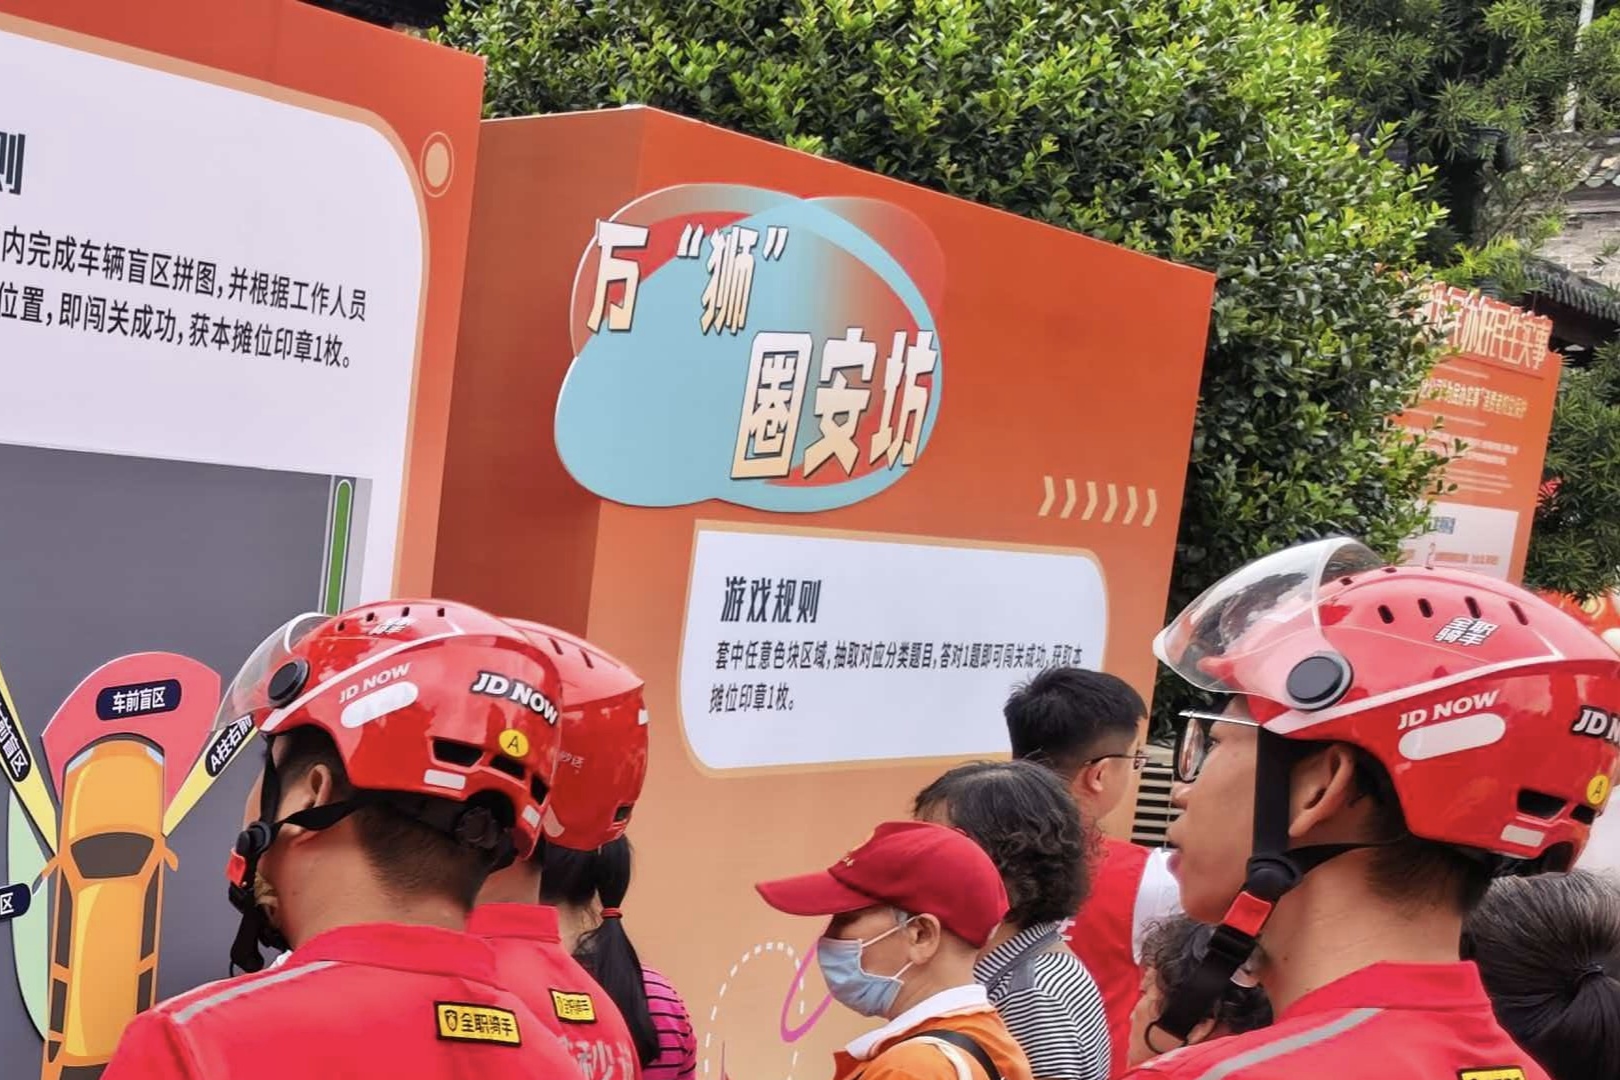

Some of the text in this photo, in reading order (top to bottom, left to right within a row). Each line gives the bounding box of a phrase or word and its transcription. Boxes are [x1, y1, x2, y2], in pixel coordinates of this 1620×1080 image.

[731, 327, 938, 481] 圈安坊
[720, 577, 821, 624] 游戏规则
[112, 686, 166, 714] 车前盲区
[338, 662, 412, 704] JD NOW
[472, 672, 558, 725] JD NOW
[1398, 690, 1499, 731] JD NOW
[1572, 708, 1608, 735] JD
[507, 735, 521, 753] A
